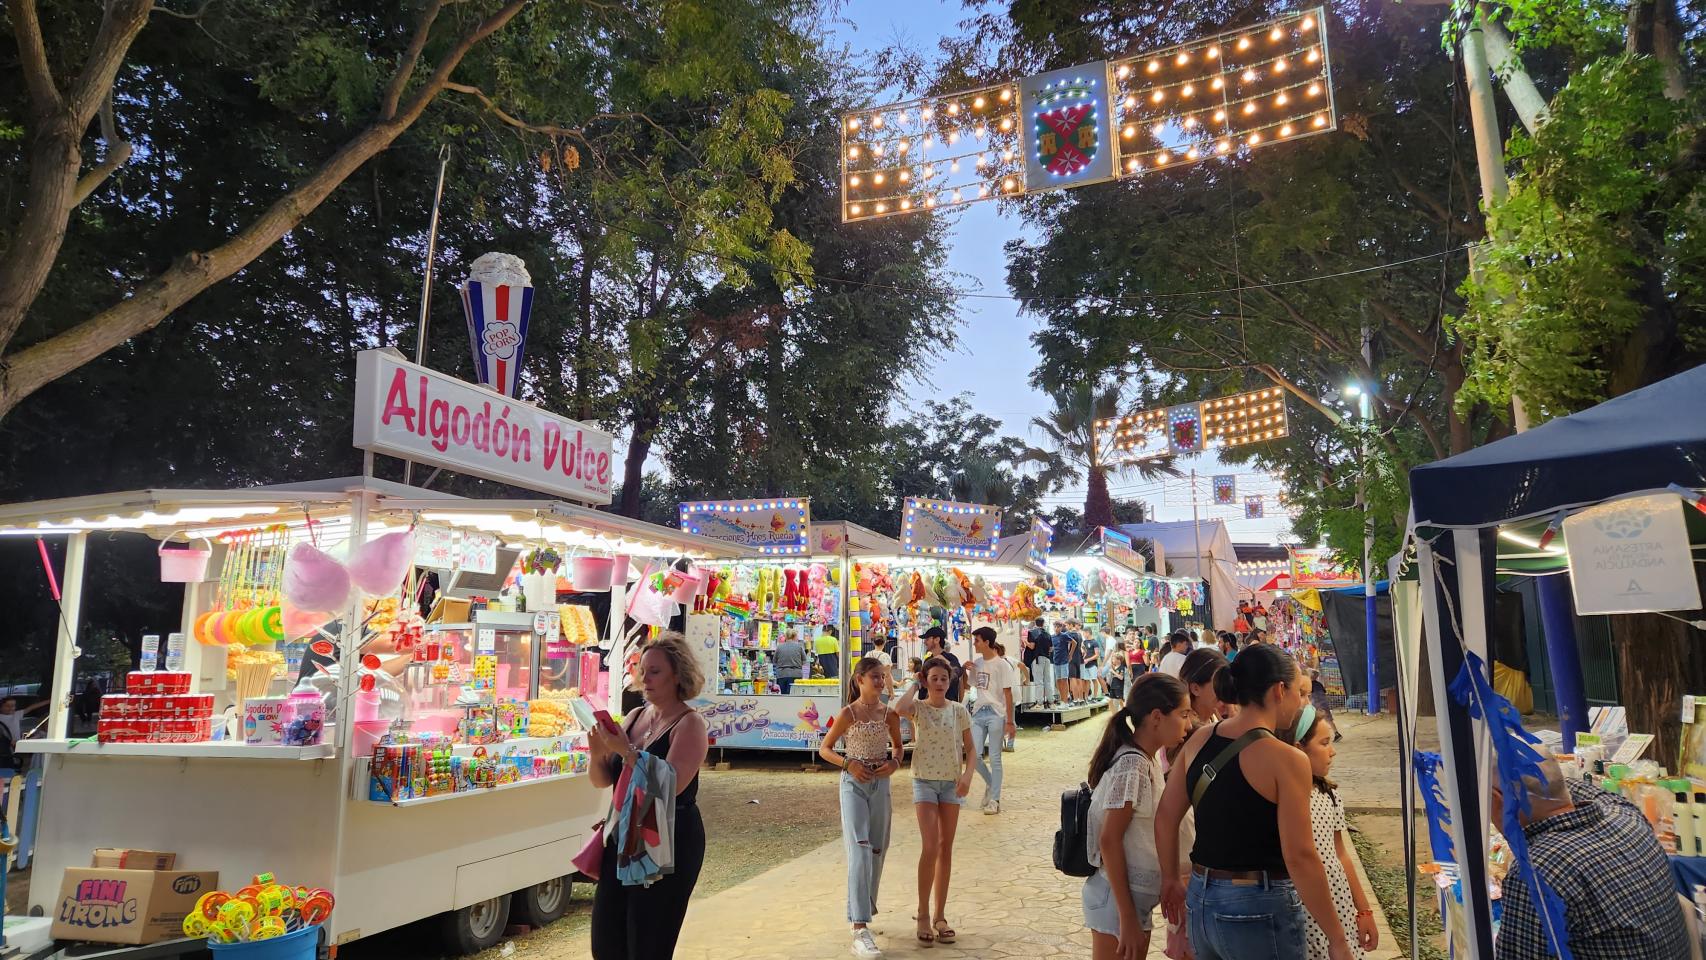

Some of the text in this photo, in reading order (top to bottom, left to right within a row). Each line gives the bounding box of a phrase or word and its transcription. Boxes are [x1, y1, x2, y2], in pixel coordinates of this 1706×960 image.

[488, 328, 509, 342] POP
[489, 335, 517, 351] CORN
[381, 367, 609, 485] Algodón Dulce
[77, 879, 127, 902] FINI
[174, 876, 199, 892] Fini
